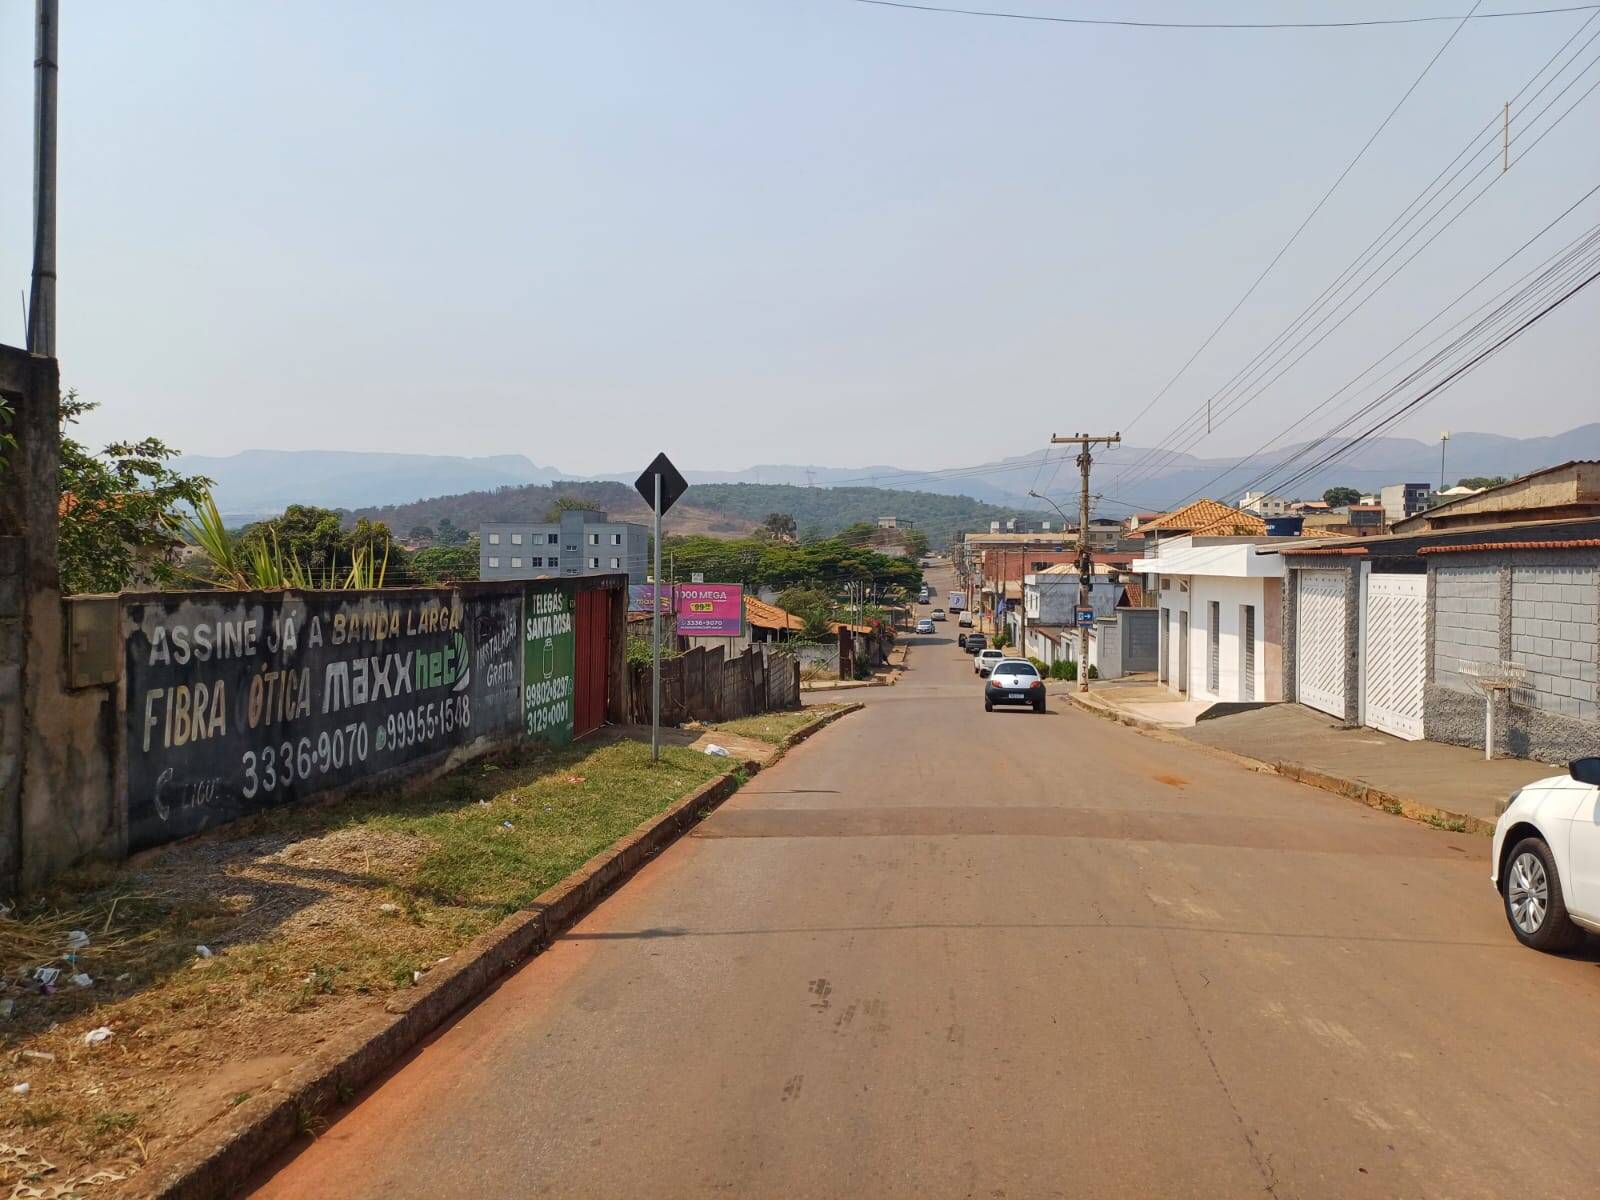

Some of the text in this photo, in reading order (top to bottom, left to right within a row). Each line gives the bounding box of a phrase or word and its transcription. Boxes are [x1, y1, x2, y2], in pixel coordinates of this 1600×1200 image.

[532, 588, 563, 614] TELEGÁS
[699, 591, 728, 599] MEGA
[149, 606, 460, 667] ASSINE JÁ A BANDA LARGA
[526, 612, 572, 641] SANTA ROSA
[143, 679, 227, 752] FIBRA
[247, 662, 312, 729] ÓTICA
